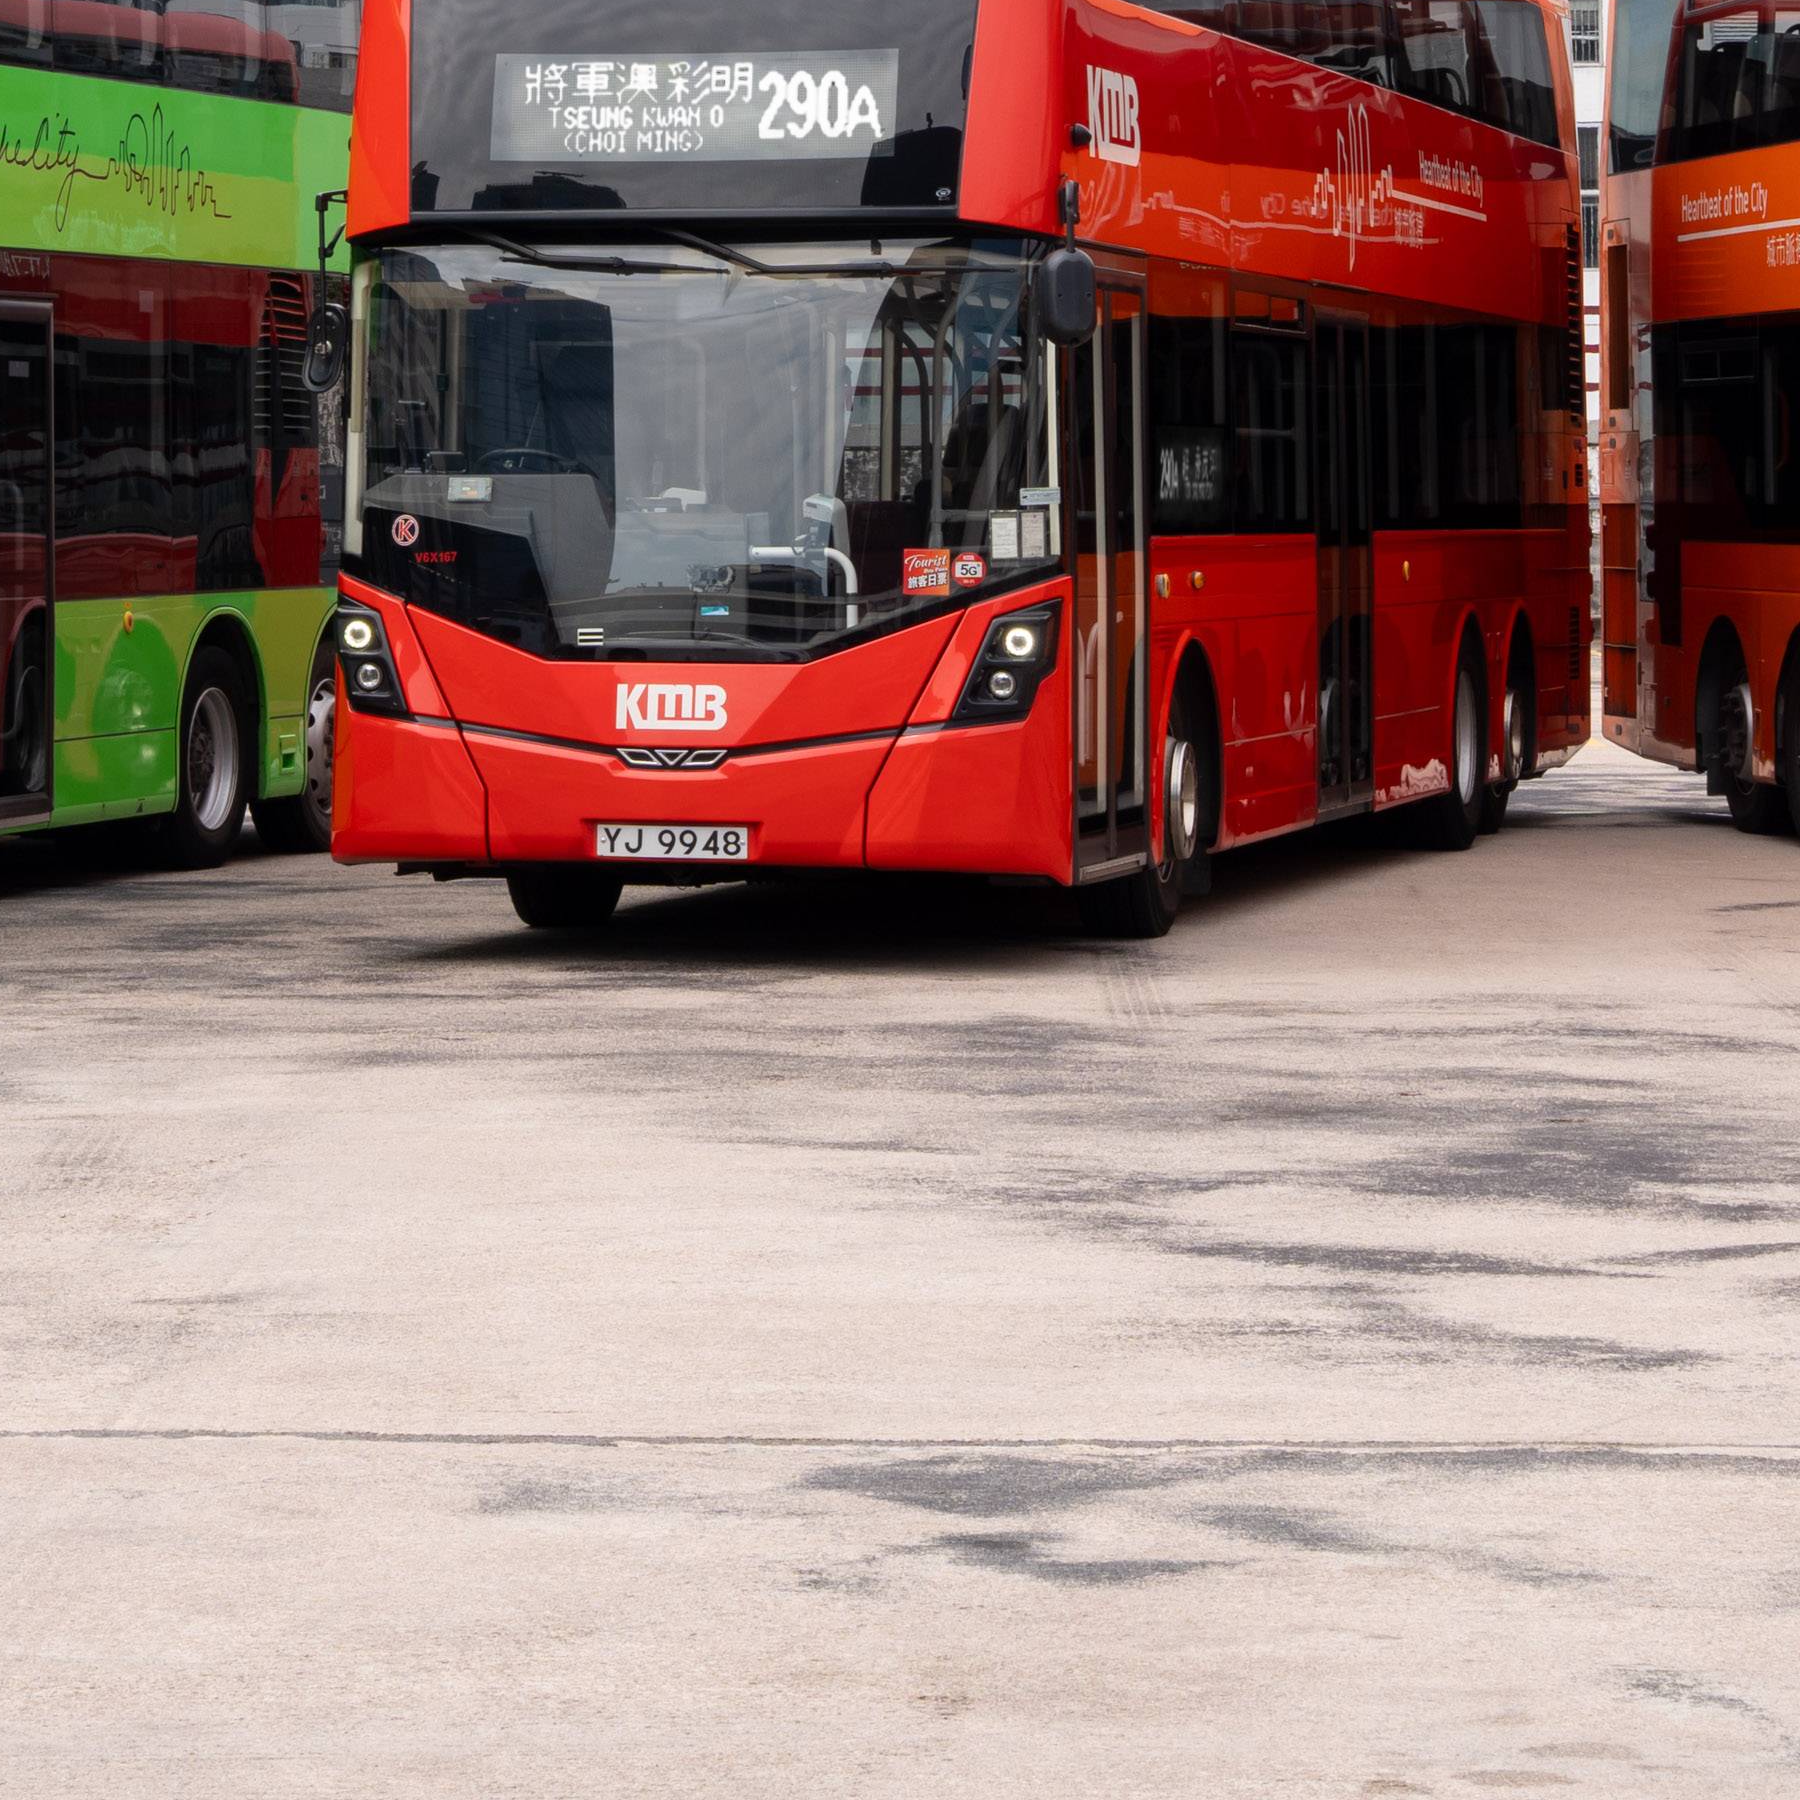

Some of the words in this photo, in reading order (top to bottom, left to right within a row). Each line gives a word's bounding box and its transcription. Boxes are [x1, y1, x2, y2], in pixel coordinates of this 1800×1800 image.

[548, 105, 634, 128] TSEUNG
[641, 106, 702, 128] KWAN
[709, 105, 725, 128] O
[757, 69, 884, 140] 290A
[563, 129, 627, 153] (CHOI
[635, 129, 705, 153] MING)
[1681, 188, 1723, 223] Heartbeat
[1723, 186, 1734, 217] of
[1734, 184, 1749, 215] the
[1750, 181, 1768, 220] City
[904, 554, 947, 572] Tourist
[604, 827, 644, 854] YJ
[657, 828, 743, 857] 9948
